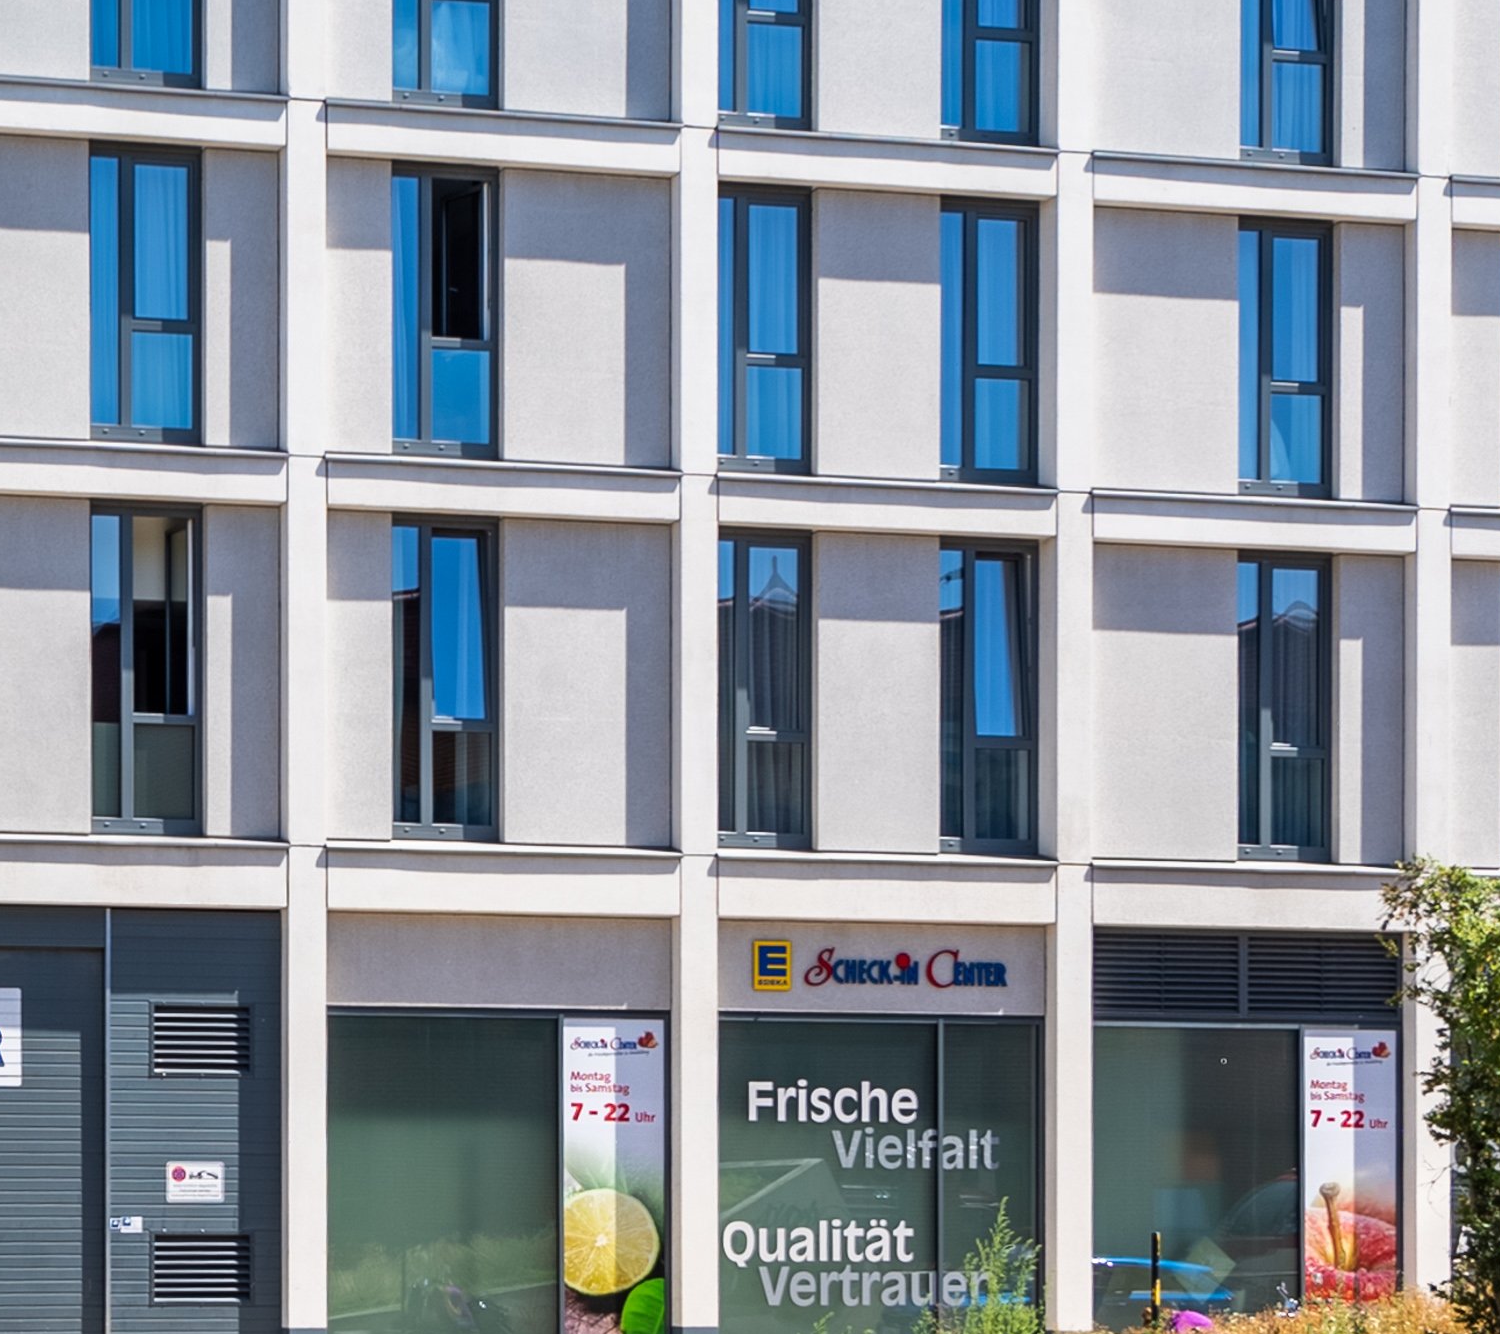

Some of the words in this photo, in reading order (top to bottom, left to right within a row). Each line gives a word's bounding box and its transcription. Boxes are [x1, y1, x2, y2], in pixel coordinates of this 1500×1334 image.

[925, 949, 1008, 988] CENTER
[570, 1071, 611, 1084] Montag
[1310, 1079, 1348, 1092] Montag
[570, 1083, 583, 1093] bis
[585, 1082, 630, 1097] Samstag
[1324, 1090, 1365, 1104] Samstag
[748, 1079, 918, 1124] Frische
[571, 1102, 584, 1121] 7
[603, 1102, 630, 1122] 22
[634, 1111, 656, 1123] Uhr
[1310, 1109, 1322, 1127] 7
[1340, 1110, 1364, 1128] 22
[1368, 1118, 1388, 1129] Uhr
[832, 1127, 1000, 1170] Vielfalt
[722, 1219, 914, 1267] Qualität
